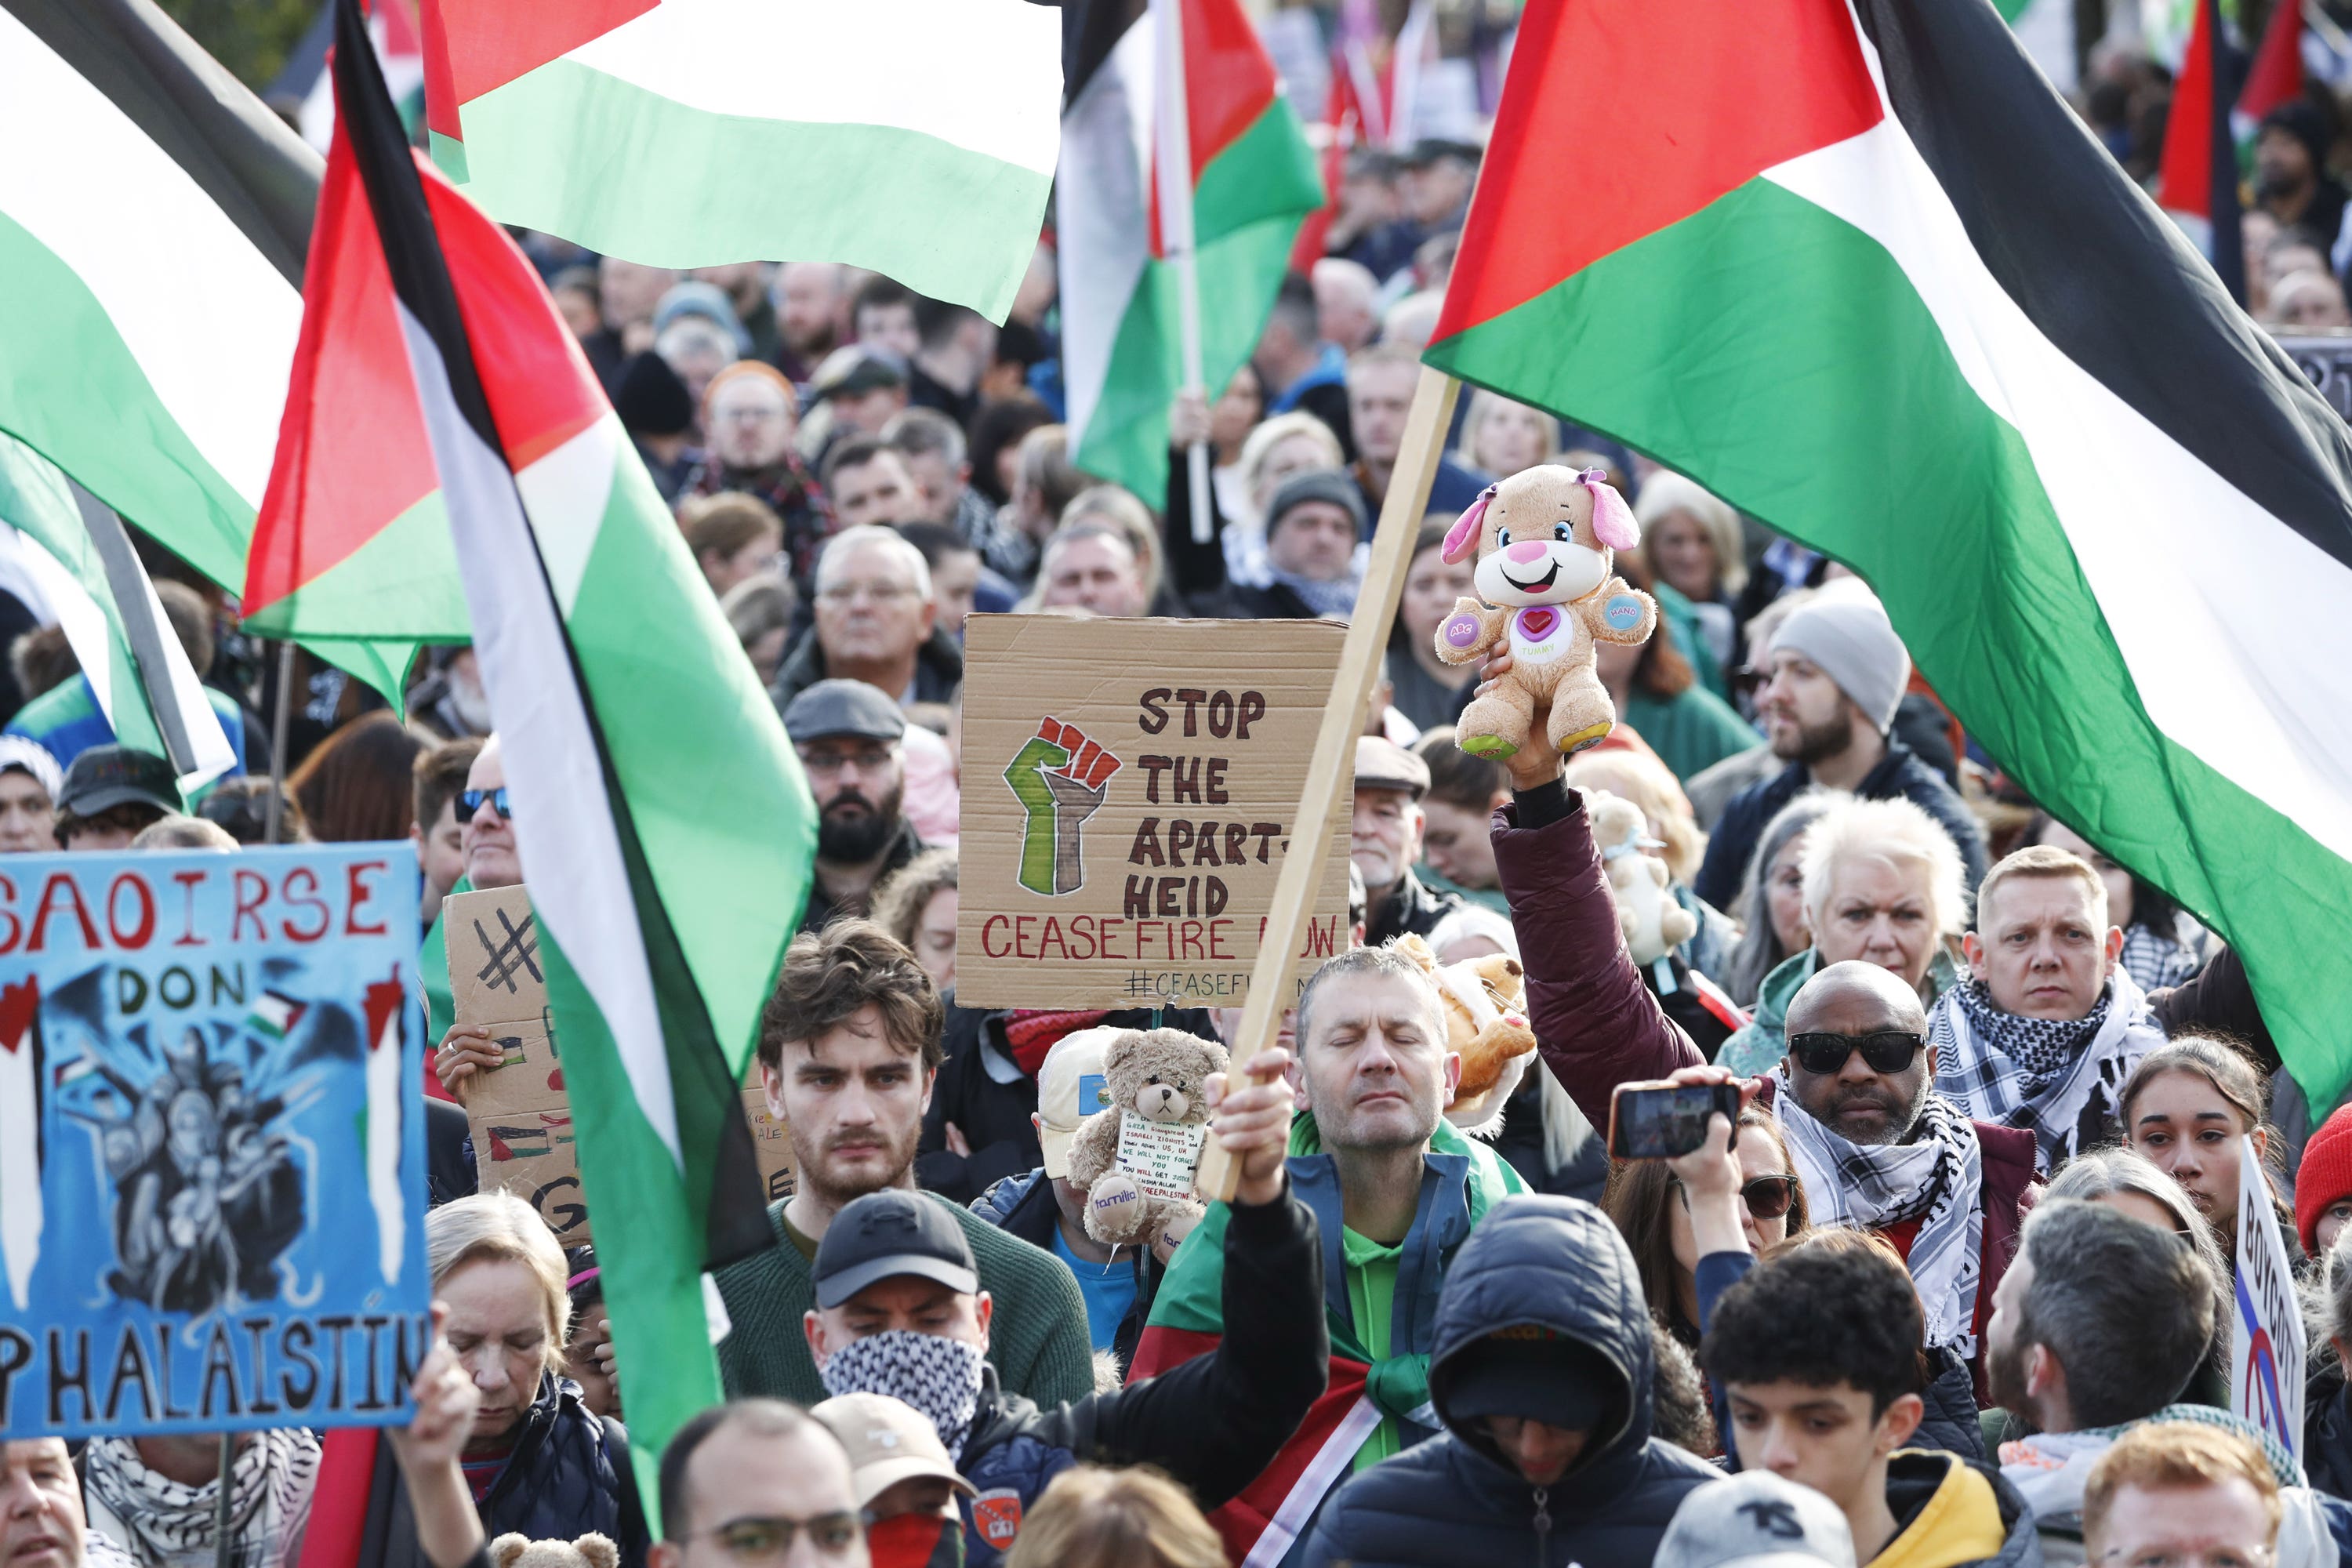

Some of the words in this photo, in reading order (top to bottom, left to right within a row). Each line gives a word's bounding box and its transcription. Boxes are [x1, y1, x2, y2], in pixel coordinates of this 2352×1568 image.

[1610, 606, 1637, 619] HAND
[1450, 623, 1472, 637] ABC
[1520, 644, 1554, 656] TUMMY
[1139, 688, 1265, 740] STOP
[1474, 747, 1502, 757] OOT
[1137, 754, 1229, 805] THE
[1123, 874, 1229, 920] HEID
[982, 914, 1236, 960] CEASEFIRE
[119, 960, 245, 1014] DON
[1126, 1122, 1145, 1131] GAZA
[1125, 1131, 1152, 1140] ISRAELI
[1174, 1156, 1193, 1165] FORGET
[1172, 1174, 1190, 1183] JUSTICE
[1094, 1189, 1136, 1210] familia
[2245, 1188, 2296, 1412] BOYCOTT
